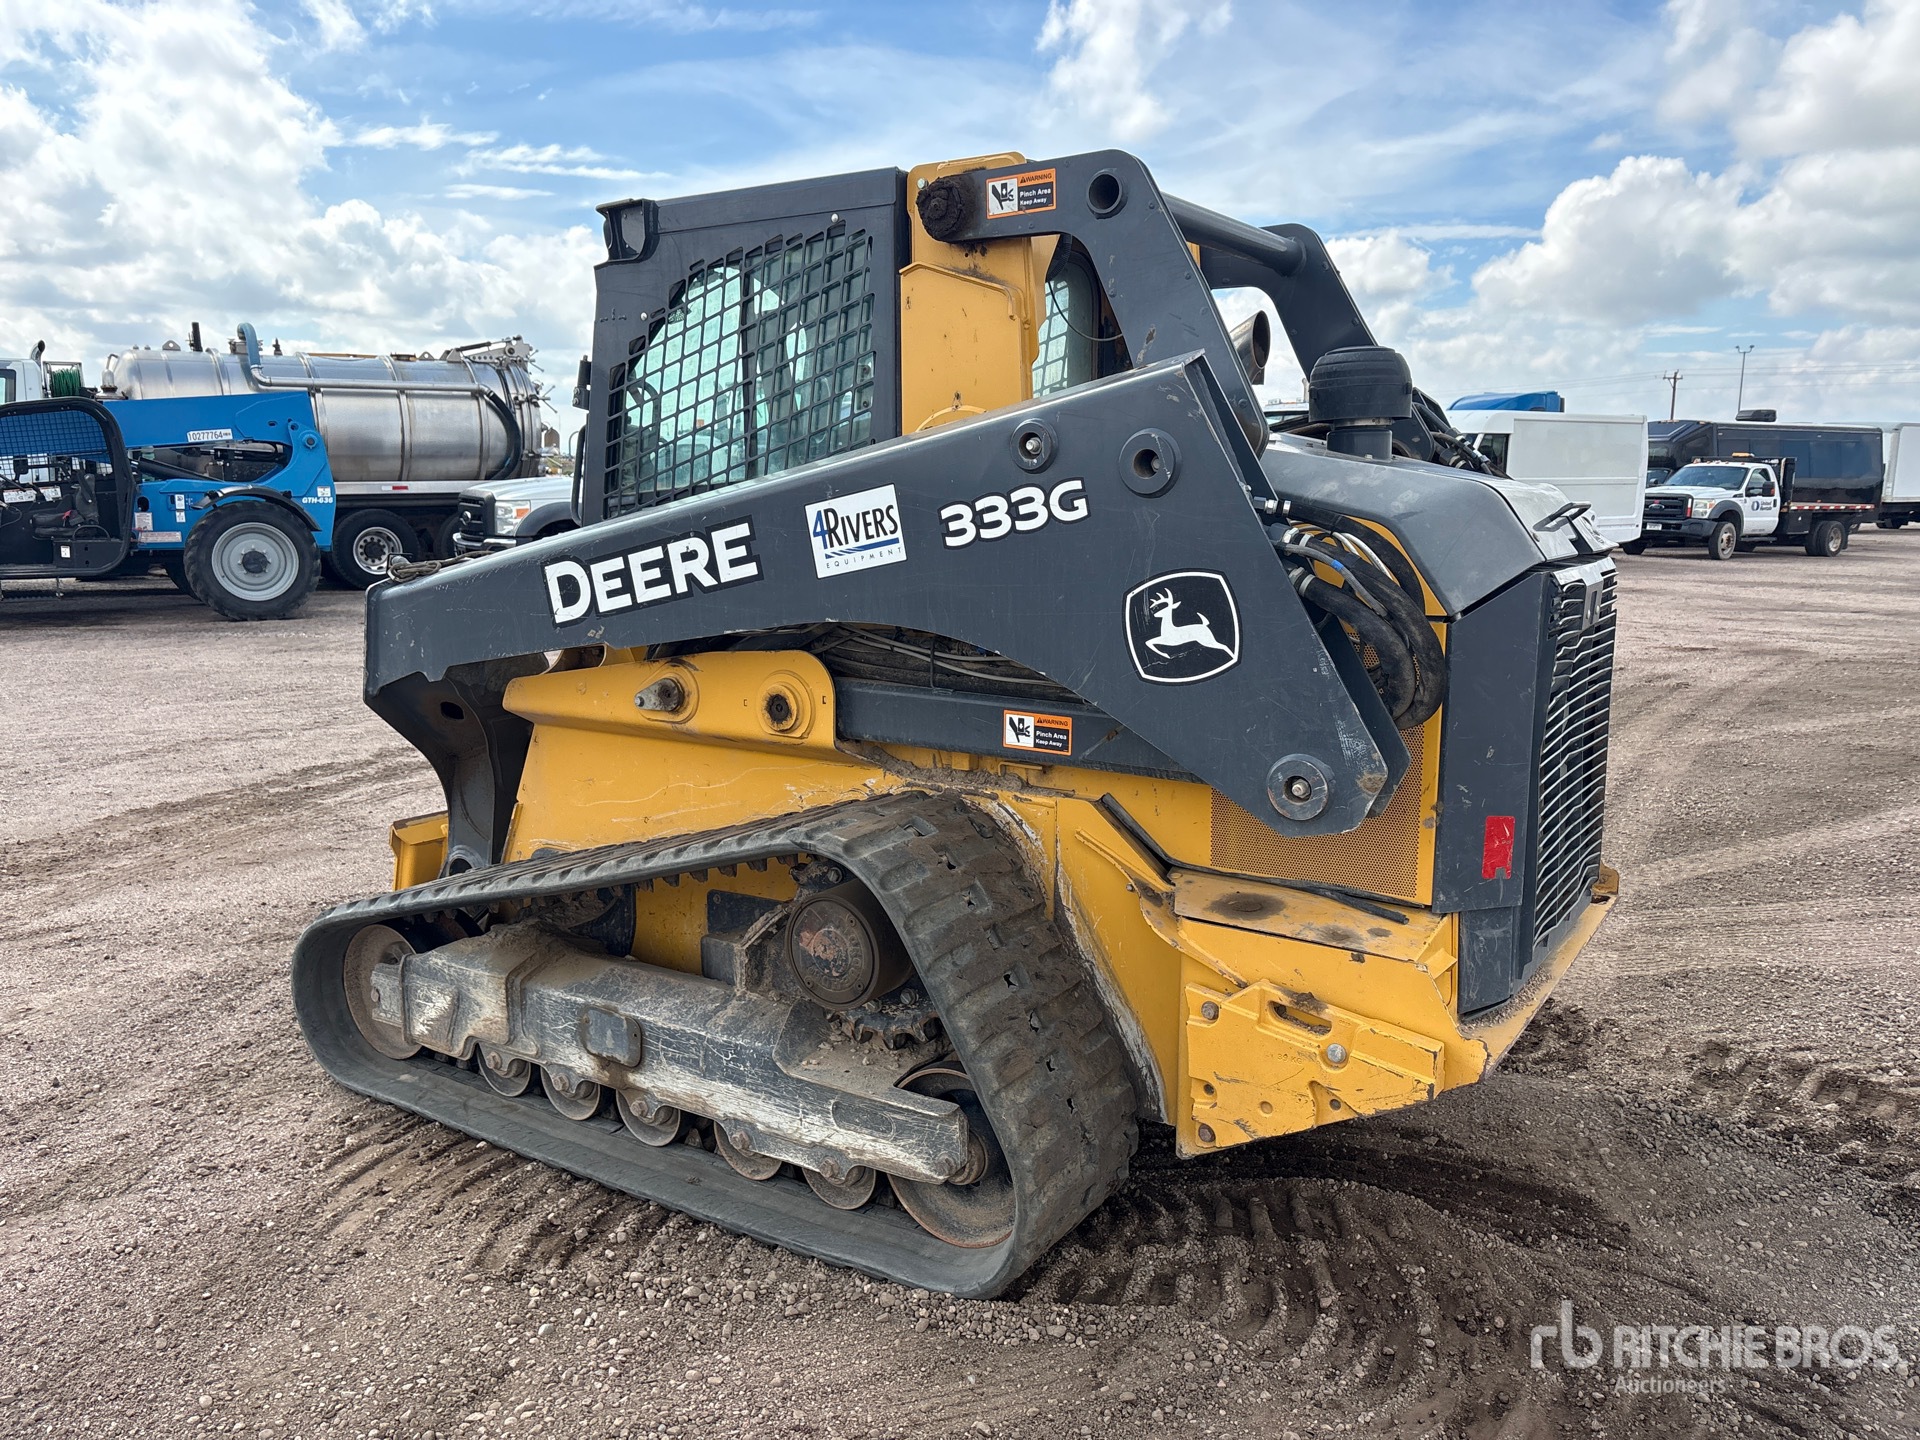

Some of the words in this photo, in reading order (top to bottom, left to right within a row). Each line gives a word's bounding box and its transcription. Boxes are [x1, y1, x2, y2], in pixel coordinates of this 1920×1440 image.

[1025, 173, 1052, 182] WARNING
[188, 431, 223, 441] 10277764
[940, 480, 1088, 547] 333G
[826, 547, 902, 569] EQUIPMENT
[545, 523, 758, 624] DEERE
